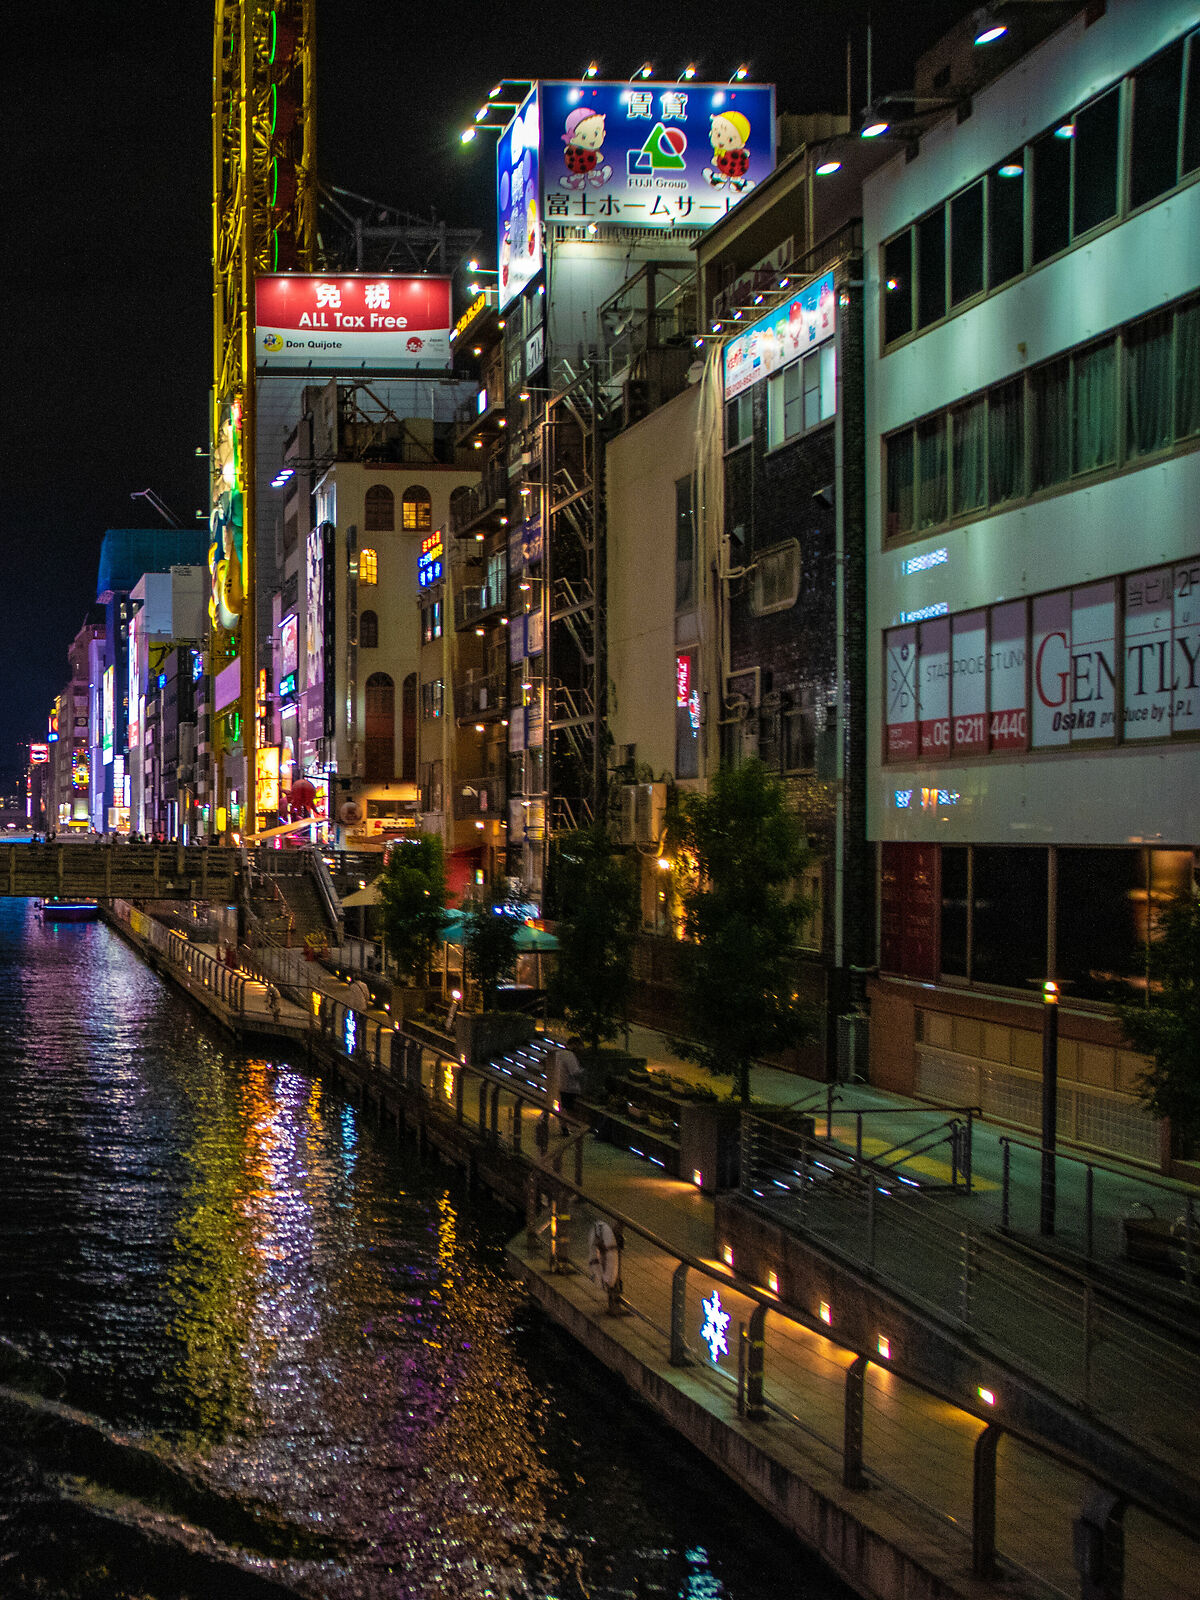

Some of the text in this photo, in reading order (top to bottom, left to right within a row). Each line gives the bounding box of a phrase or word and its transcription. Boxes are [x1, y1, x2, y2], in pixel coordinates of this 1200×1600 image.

[628, 177, 687, 191] FUJI Group
[315, 283, 391, 309] 免税
[298, 312, 408, 328] ALL Tax Free
[286, 340, 343, 351] Don Quijote
[1052, 708, 1097, 732] Osaka
[1151, 701, 1166, 723] by
[955, 716, 984, 744] 6211
